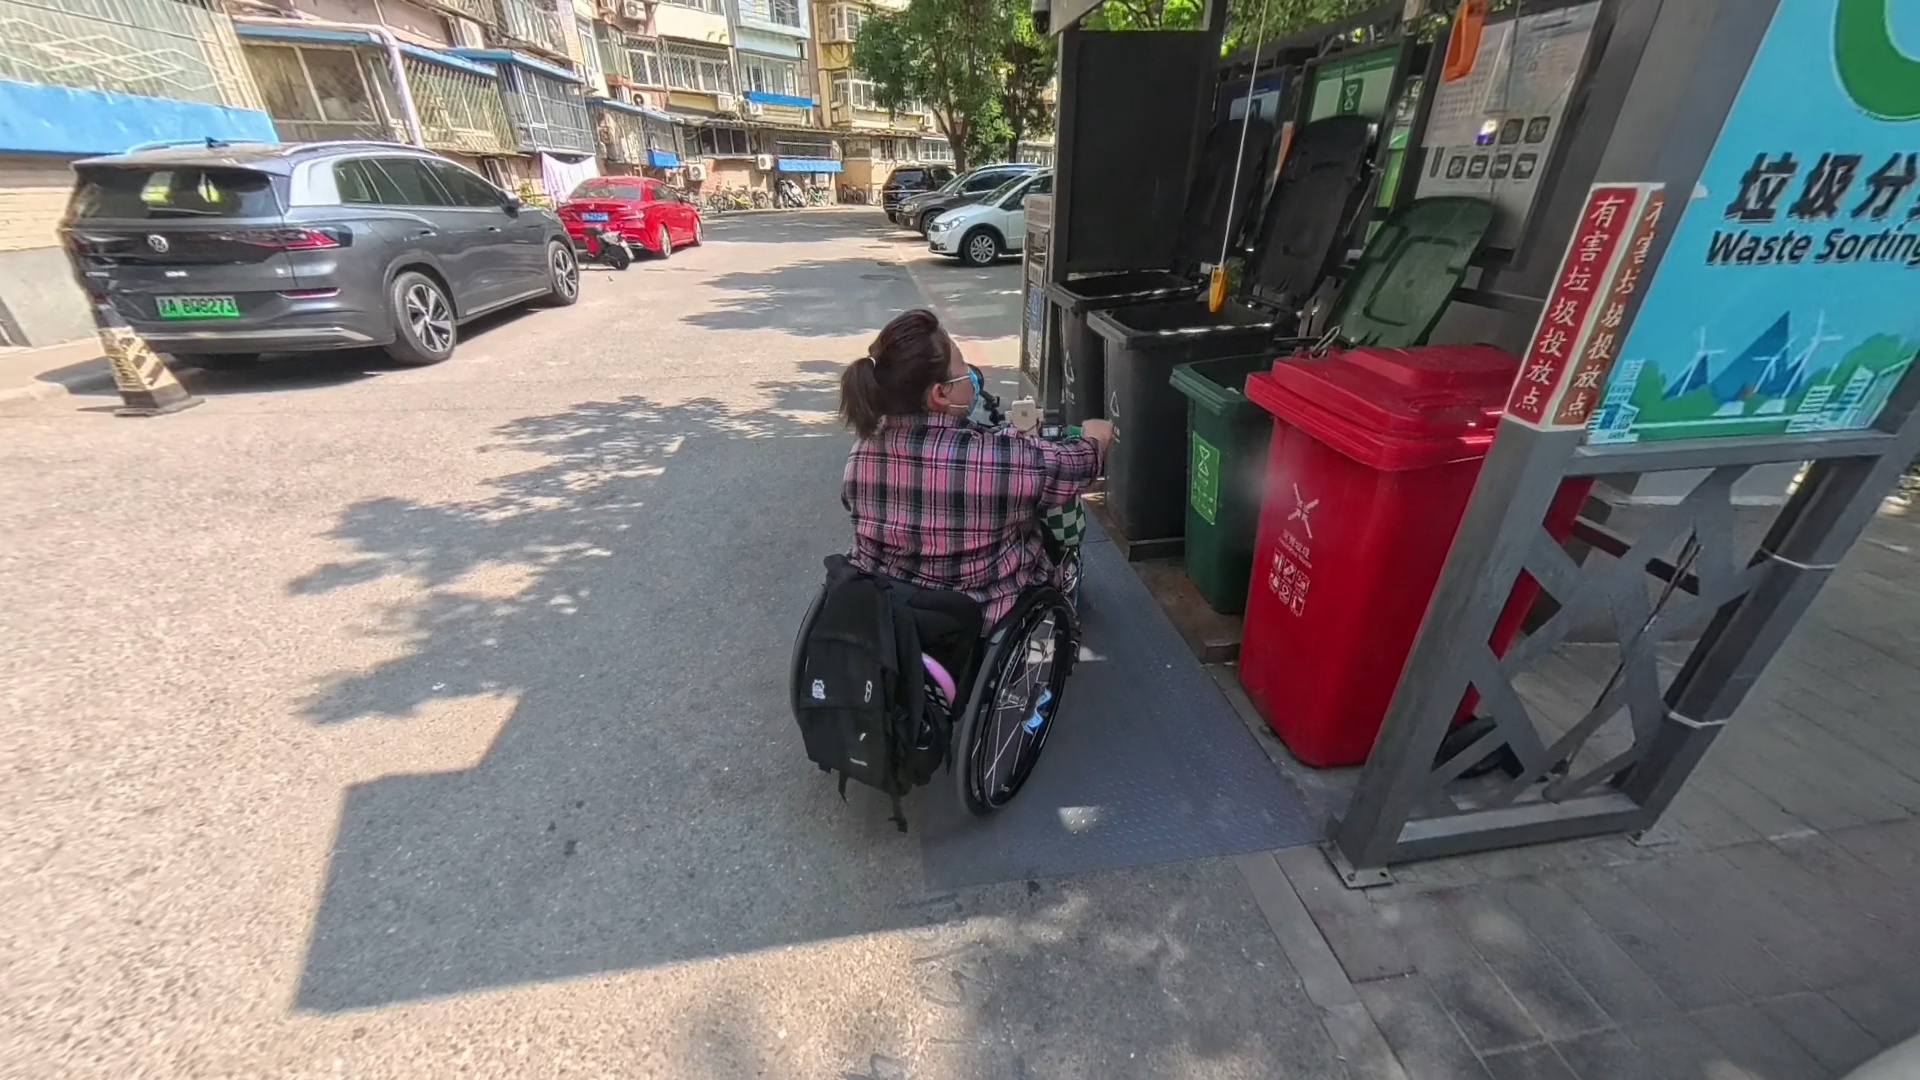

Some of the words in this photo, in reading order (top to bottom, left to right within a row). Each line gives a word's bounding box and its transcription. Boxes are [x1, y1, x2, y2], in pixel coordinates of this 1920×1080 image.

[1724, 151, 1920, 224] 垃圾分
[1705, 229, 1813, 266] Waste
[1514, 195, 1626, 415] 有害垃圾投放点
